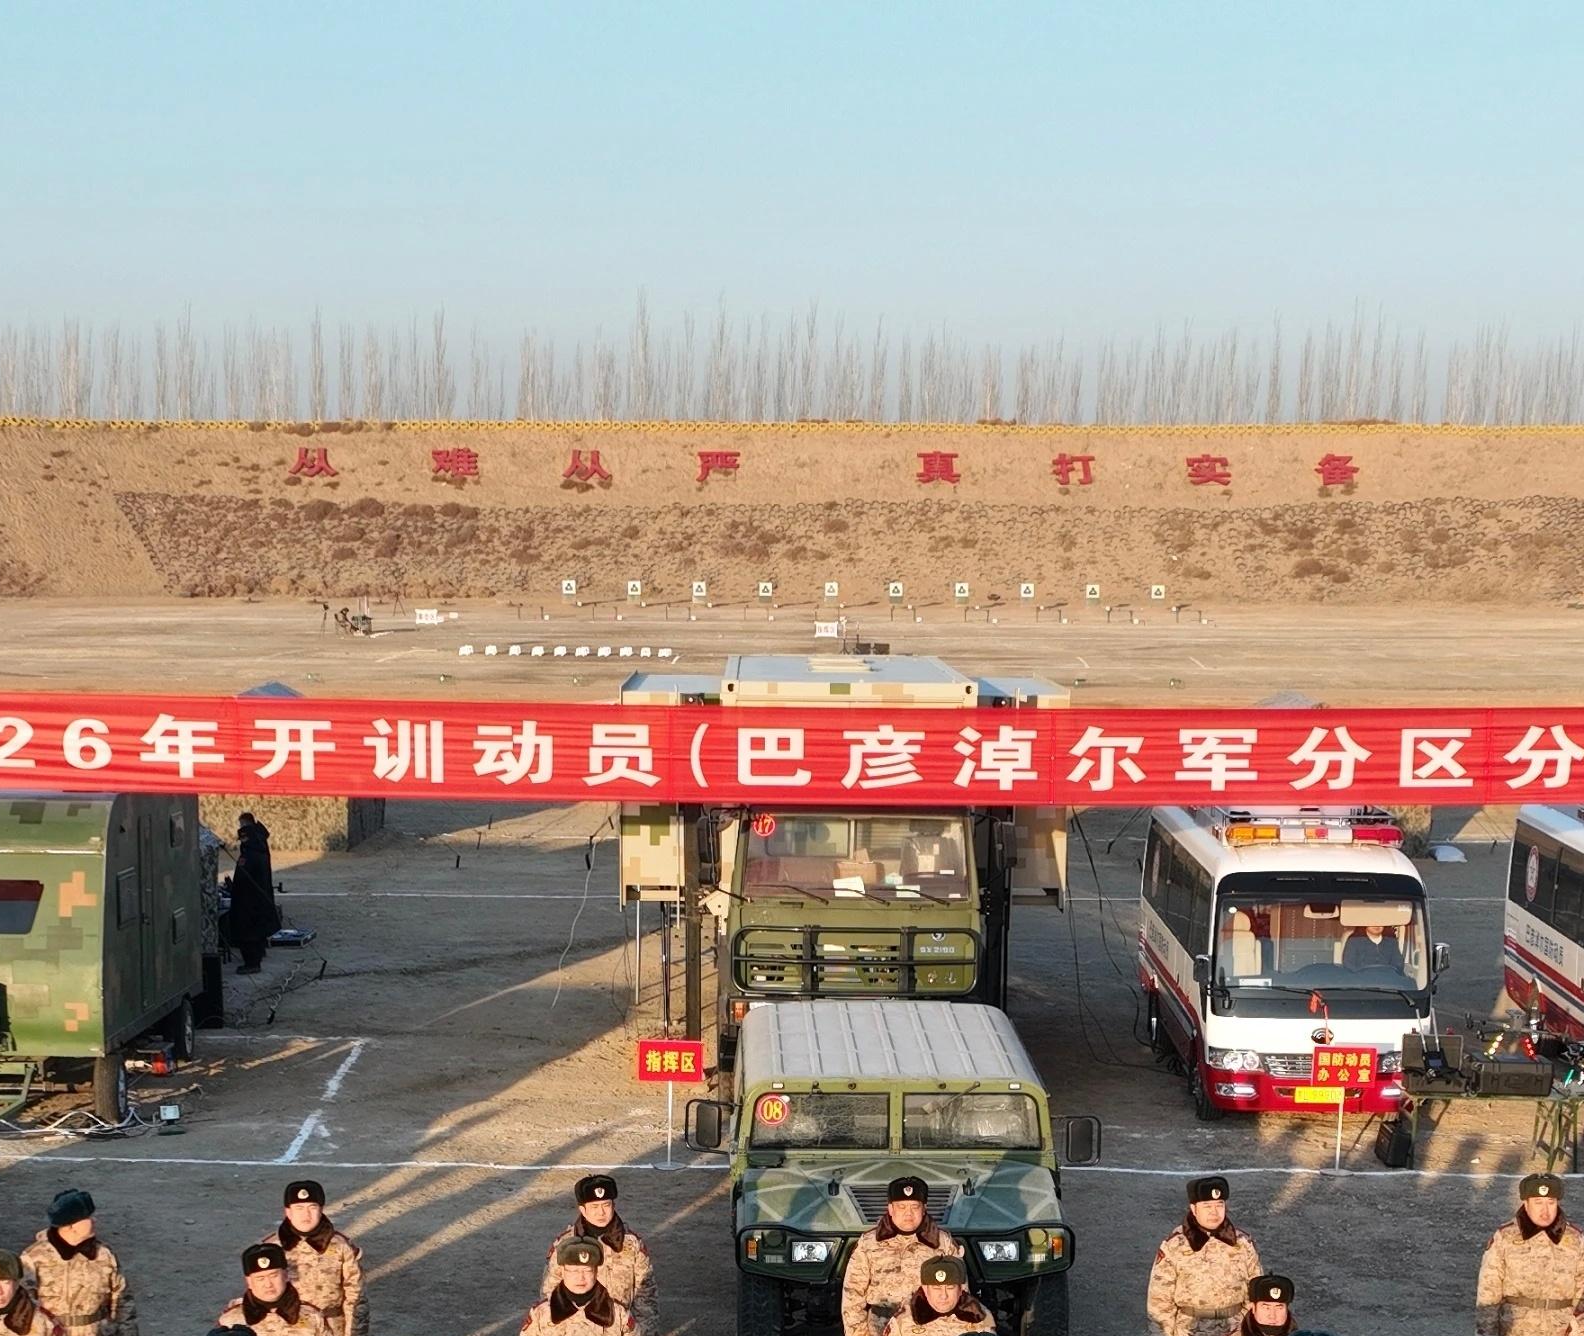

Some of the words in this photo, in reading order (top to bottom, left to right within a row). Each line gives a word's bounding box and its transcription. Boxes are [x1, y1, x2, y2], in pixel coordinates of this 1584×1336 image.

[290, 446, 740, 482] 从难从严
[916, 449, 1361, 487] 真打实备
[645, 1049, 696, 1073] 指挥区
[1317, 1051, 1372, 1067] 国防动员
[1317, 1068, 1372, 1083] 办公室
[761, 1098, 785, 1122] 08
